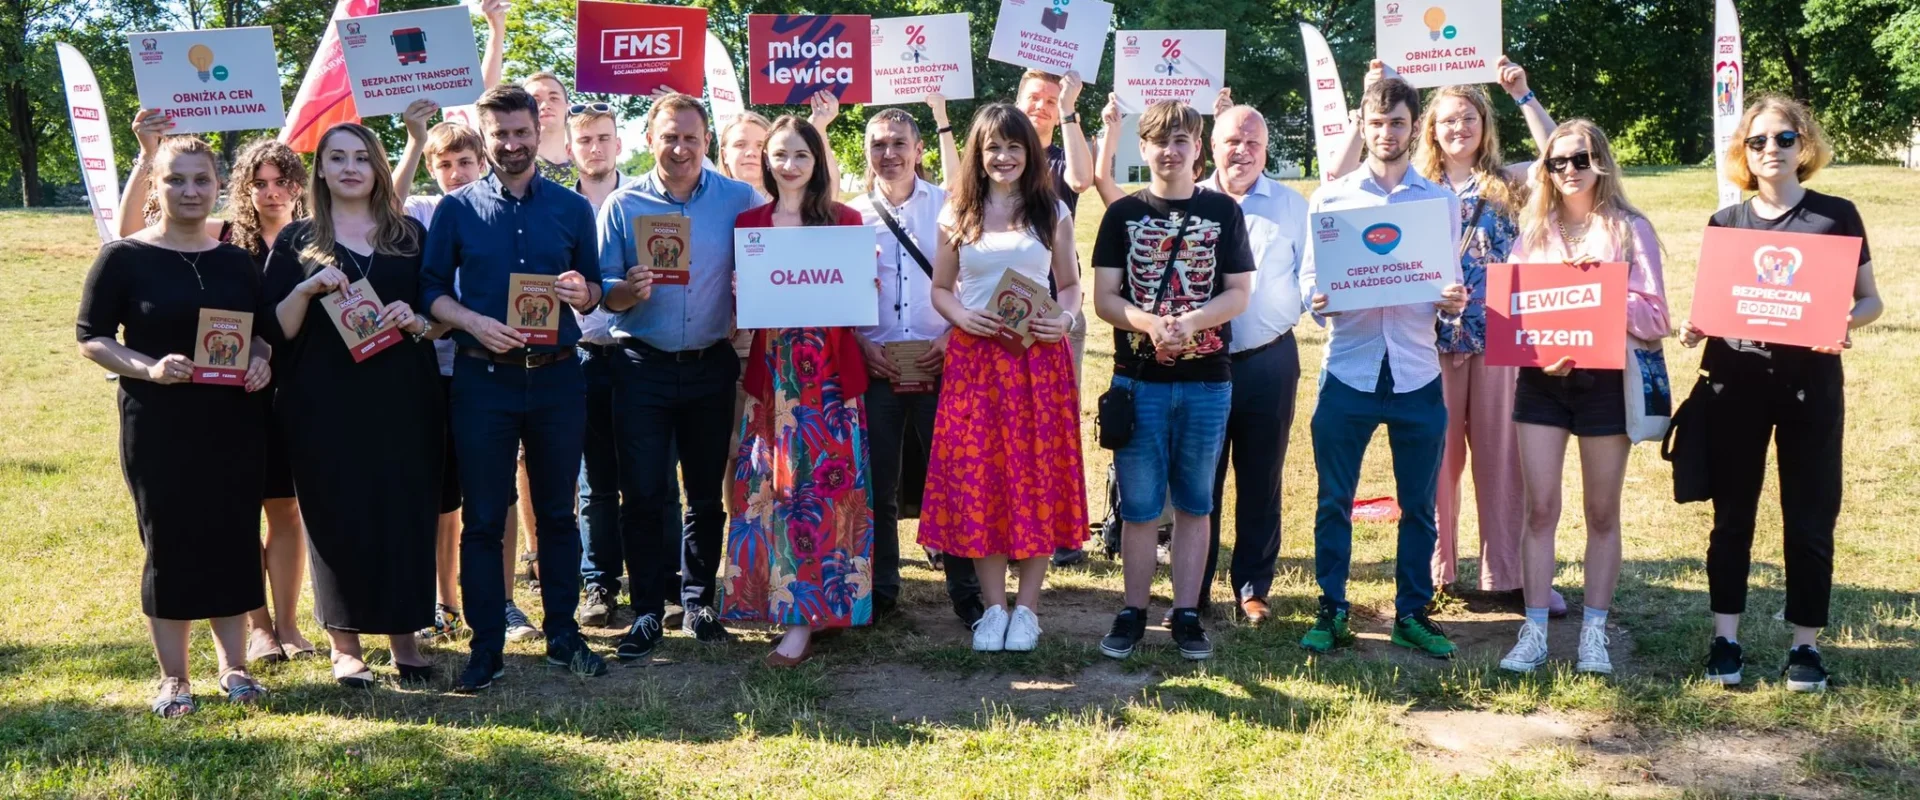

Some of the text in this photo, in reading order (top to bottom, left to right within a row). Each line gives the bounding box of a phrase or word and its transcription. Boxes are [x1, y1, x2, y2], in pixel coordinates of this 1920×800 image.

[614, 34, 670, 56] FMS
[768, 37, 852, 59] młoda
[1020, 30, 1078, 51] WYŻSZE PŁACE
[1018, 50, 1071, 69] PUBLICZNYCH
[1031, 45, 1074, 59] USŁUGACH
[1406, 47, 1476, 60] OBNIŻKA CEN
[769, 61, 852, 84] lewica
[875, 68, 904, 76] WALKA
[914, 63, 959, 73] DROŻYZNĄ
[1397, 63, 1436, 75] ENERGII
[1446, 60, 1485, 70] PALIWA
[362, 67, 470, 87] BEZPŁATNY TRANSPORT
[895, 76, 921, 85] NIŻSZE
[924, 75, 945, 83] RATY
[1166, 78, 1210, 87] DROŻYZNĄ
[173, 89, 253, 103] OBNIŻKA CEN
[364, 90, 383, 98] DLA
[386, 85, 415, 96] DZIECI
[423, 78, 473, 91] MŁODZIEŻY
[895, 85, 941, 95] KREDYTÓW
[165, 104, 266, 119] ENERGII I PALIWA
[1347, 261, 1423, 276] CIEPŁY POSIŁEK
[770, 269, 844, 285] OŁAWA
[1331, 272, 1442, 290] DLA KAŻDEGO UCZNIA
[1516, 288, 1595, 311] LEWICA
[1732, 286, 1812, 303] BEZPIECZNA
[1740, 302, 1798, 317] RODZINA
[1516, 329, 1593, 346] razem
